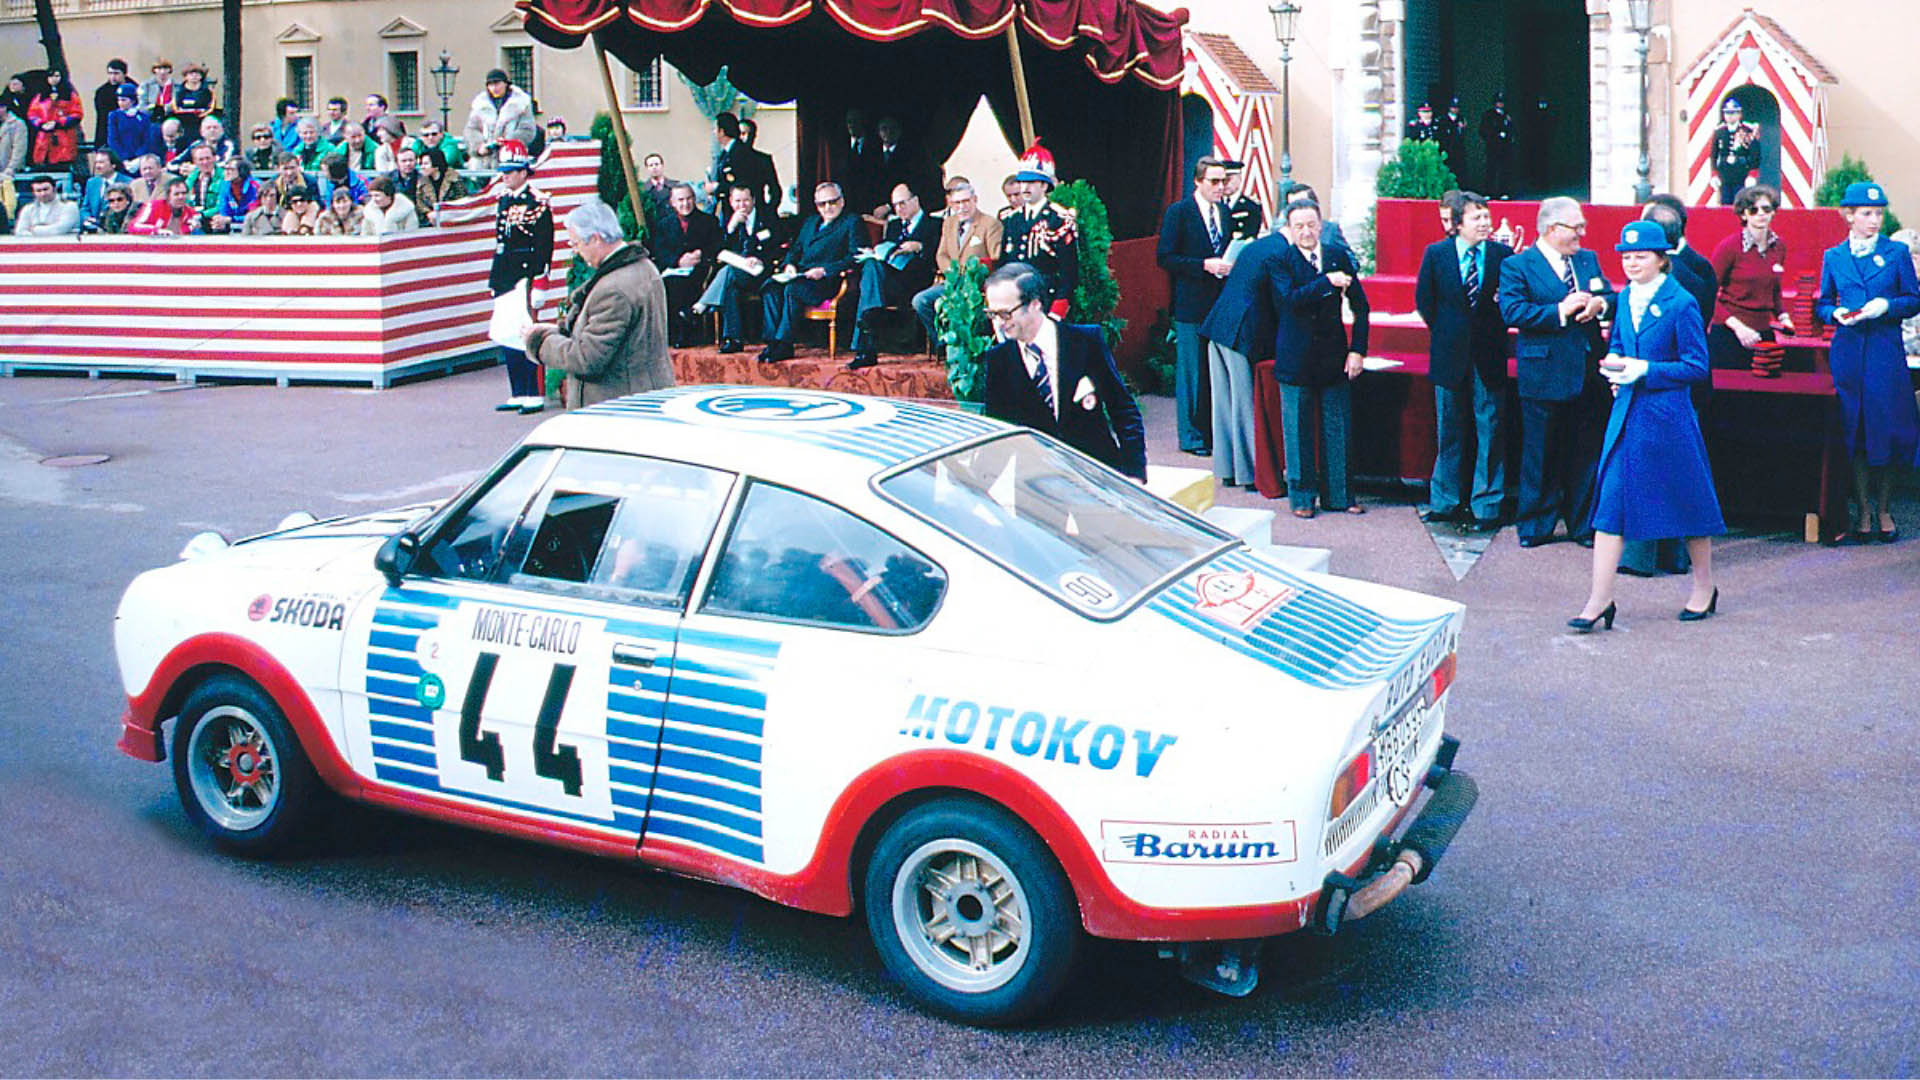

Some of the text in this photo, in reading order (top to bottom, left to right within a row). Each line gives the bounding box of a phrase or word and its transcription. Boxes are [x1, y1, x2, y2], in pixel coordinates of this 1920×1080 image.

[459, 652, 584, 797] 44
[899, 694, 1178, 777] MOTOKOV
[1133, 832, 1280, 860] Barum
[1188, 829, 1249, 840] RADIAL
